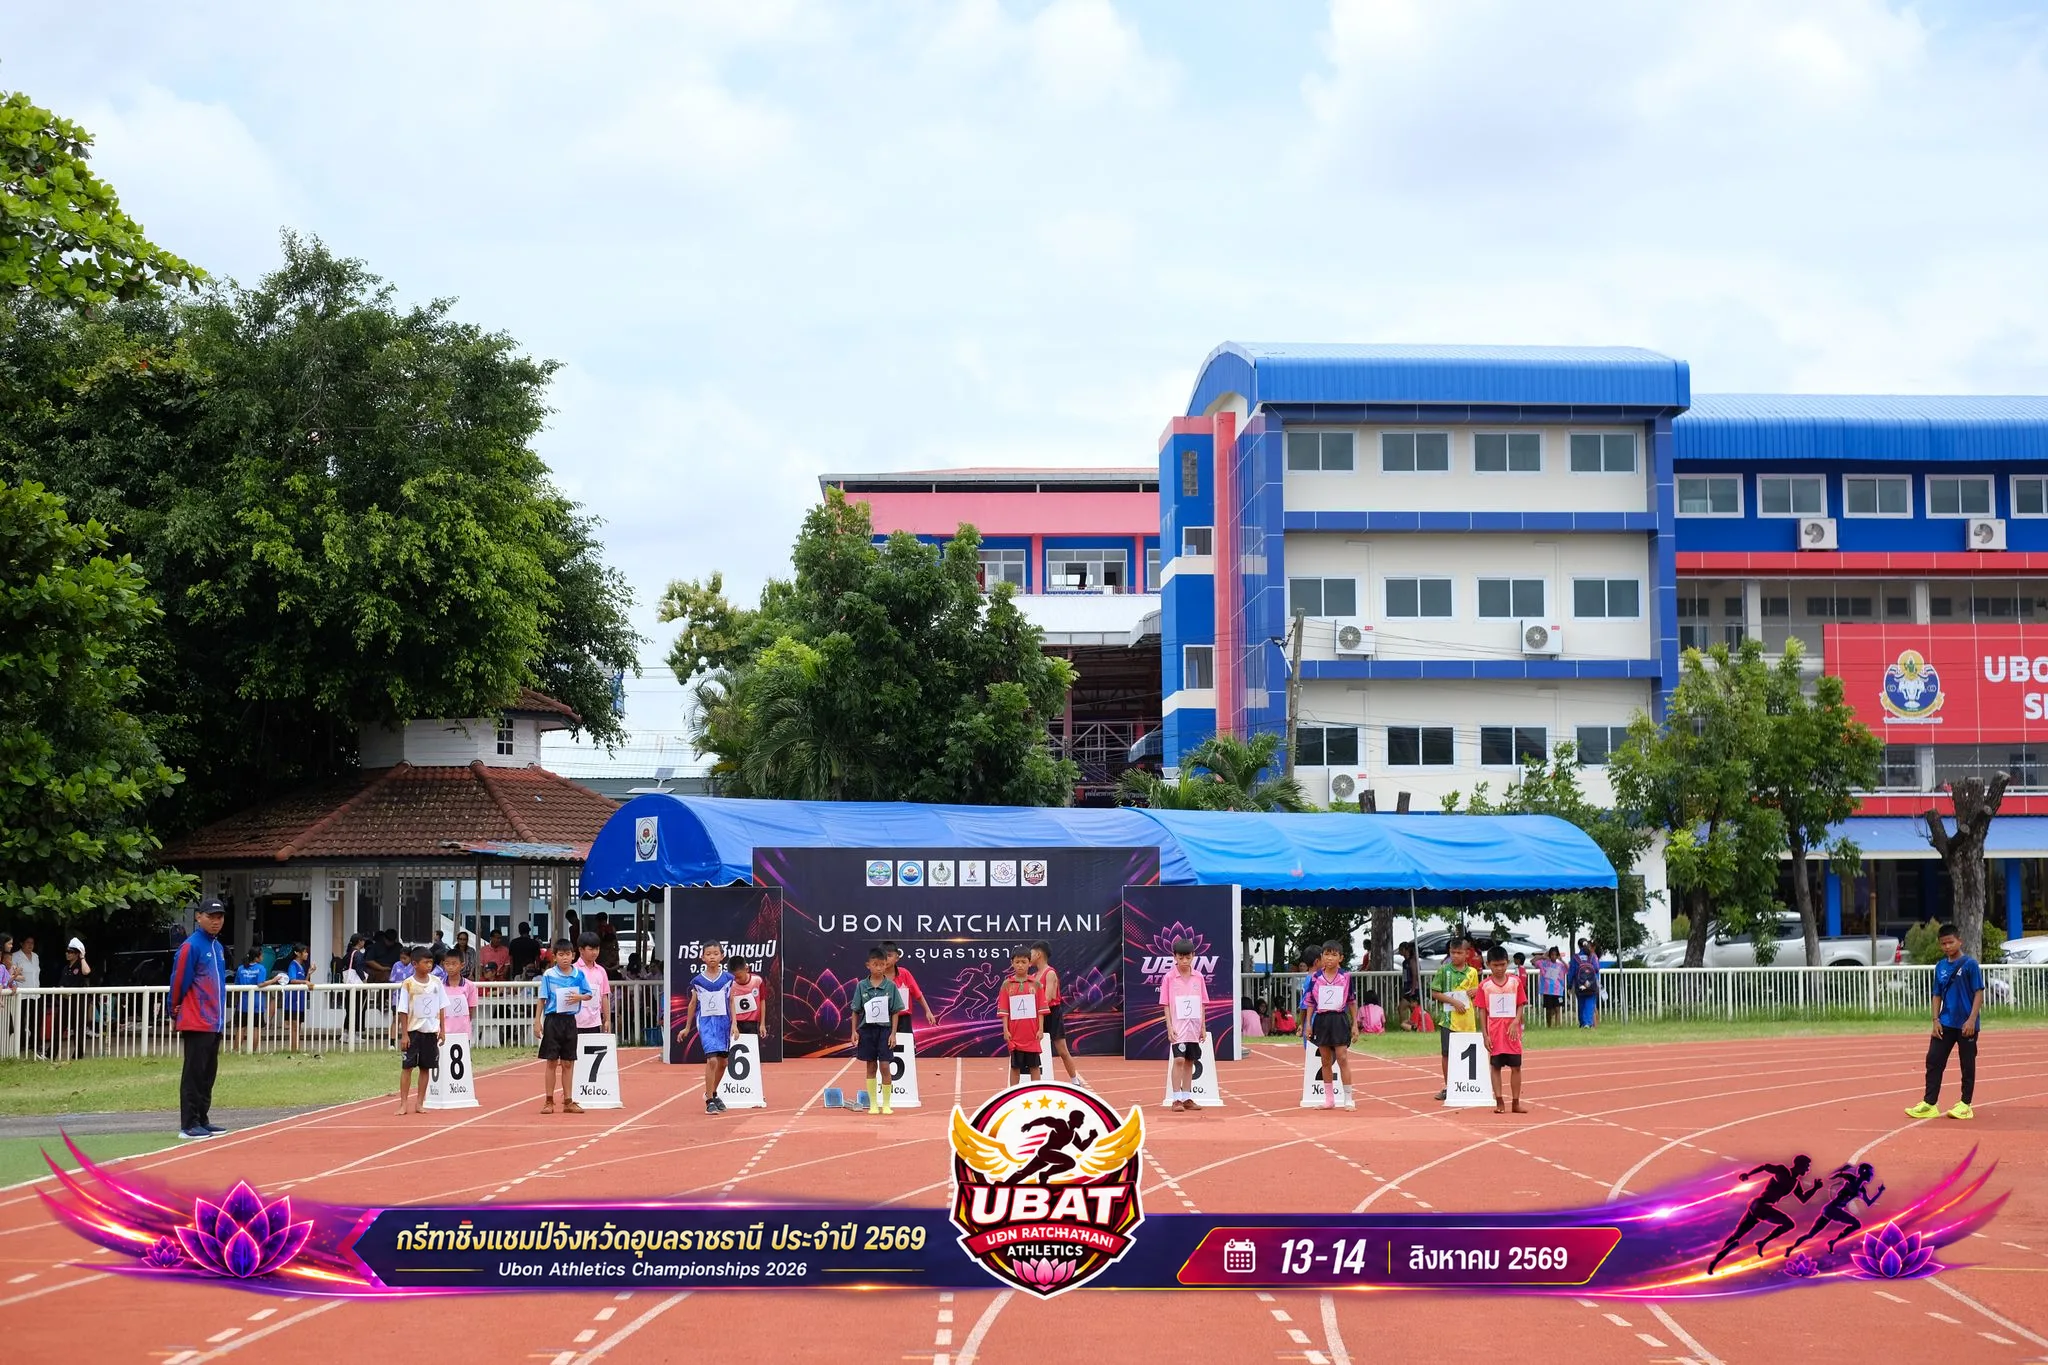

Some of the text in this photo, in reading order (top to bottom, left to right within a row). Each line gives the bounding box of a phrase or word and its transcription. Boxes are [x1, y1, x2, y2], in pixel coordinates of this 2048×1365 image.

[2024, 692, 2048, 720] S
[818, 914, 1100, 932] UBON RATCHATHANI
[1141, 956, 1219, 974] UBN
[453, 998, 463, 1013] 8
[708, 995, 716, 1009] 6
[739, 998, 750, 1010] 6
[1324, 989, 1335, 1005] 2
[1496, 997, 1508, 1013] 1
[423, 998, 433, 1015] 8
[871, 1000, 882, 1018] 5
[1017, 998, 1028, 1016] 4
[1183, 1000, 1193, 1017] 3
[450, 1044, 464, 1080] 8
[584, 1046, 607, 1082] 7
[727, 1044, 750, 1080] 6
[1461, 1044, 1477, 1080] 1
[449, 1083, 467, 1094] Nelco
[580, 1085, 608, 1096] Nelco
[723, 1083, 751, 1094] Nelco
[1454, 1081, 1480, 1092] Nelco
